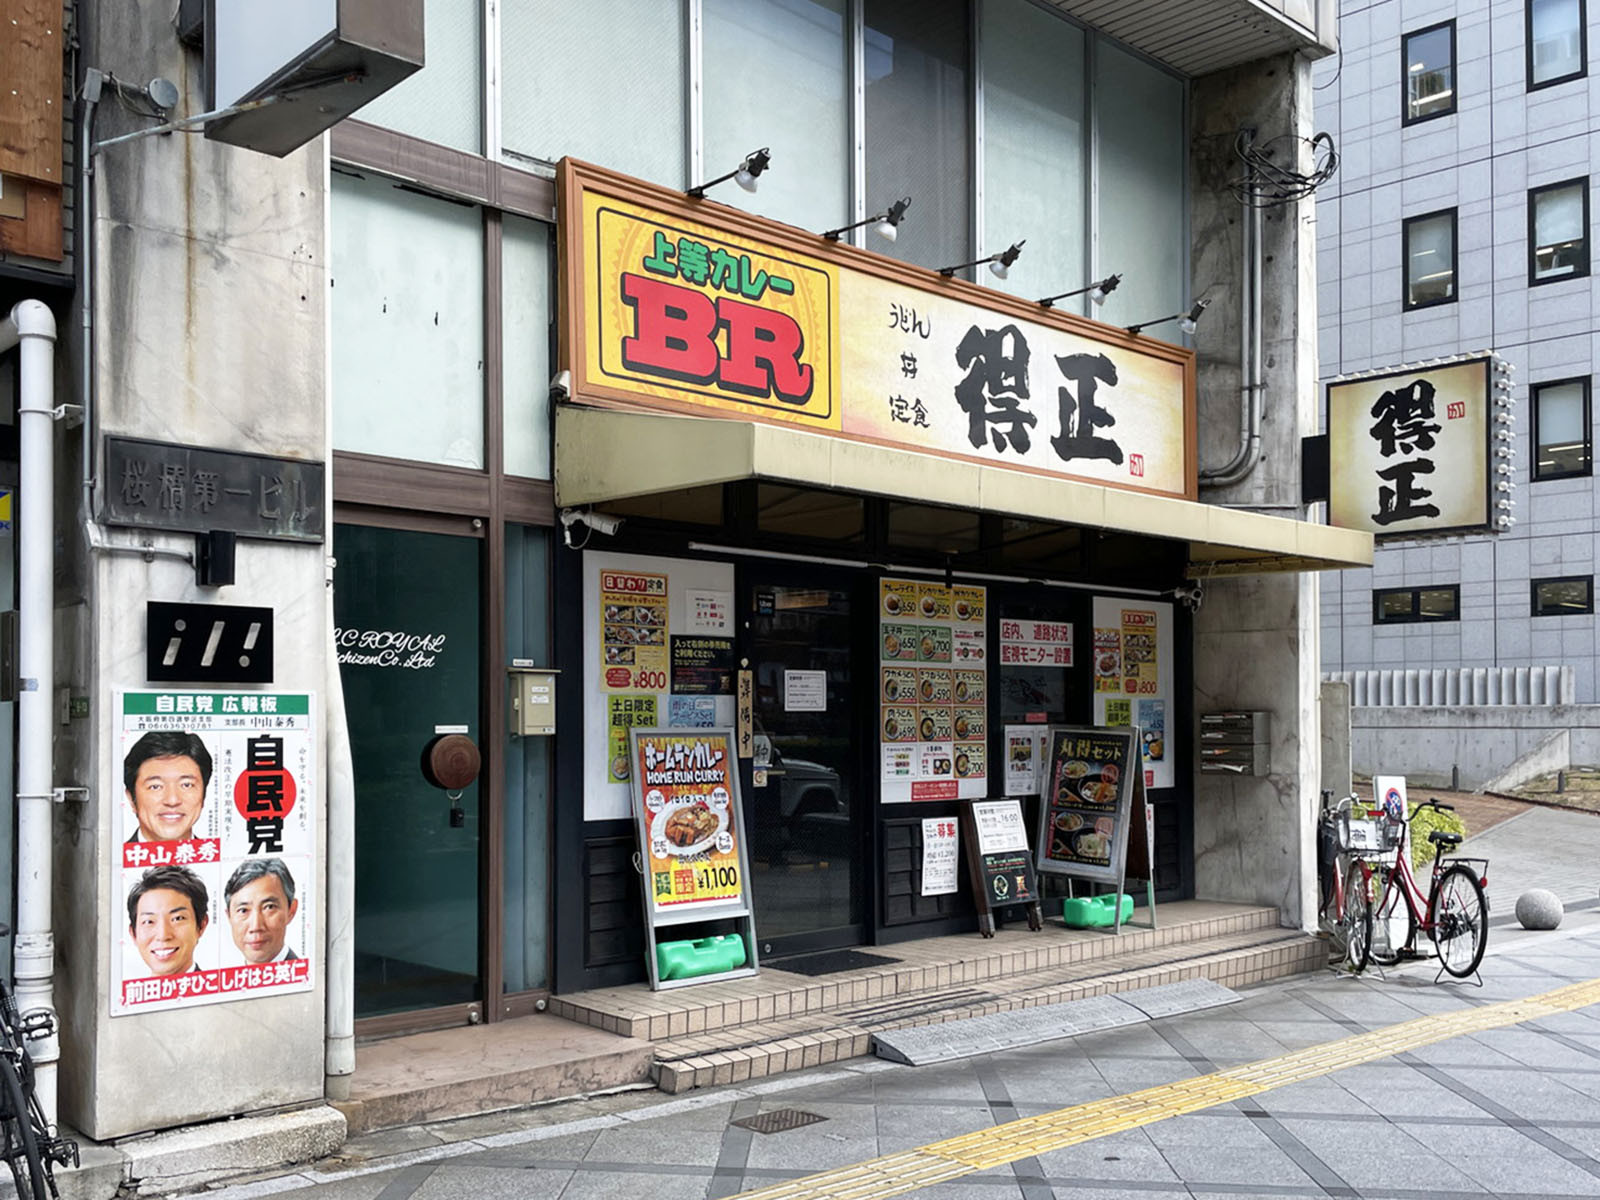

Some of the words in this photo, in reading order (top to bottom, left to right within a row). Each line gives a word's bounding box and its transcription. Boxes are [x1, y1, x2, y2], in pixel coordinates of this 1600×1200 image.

[643, 231, 795, 301] 上等カレー
[888, 303, 931, 340] うどん
[620, 272, 814, 406] BR
[954, 323, 1124, 468] 得正
[889, 394, 931, 434] 定食
[1370, 378, 1442, 526] 得正
[1002, 645, 1072, 664] 監視モニター設置
[156, 695, 213, 712] 自民党
[222, 696, 277, 712] 広報板
[612, 699, 654, 712] 土日限定
[637, 715, 654, 725] Set
[645, 741, 723, 771] ホームランカレー
[646, 771, 673, 786] HOME
[674, 771, 693, 785] RUN
[694, 769, 725, 784] CURRY
[246, 734, 284, 855] 自民党
[126, 842, 220, 866] 中山泰秀
[698, 866, 738, 890] ¥1,100
[124, 973, 219, 1005] 前田かずひこ
[221, 961, 308, 990] しげはら英仁
